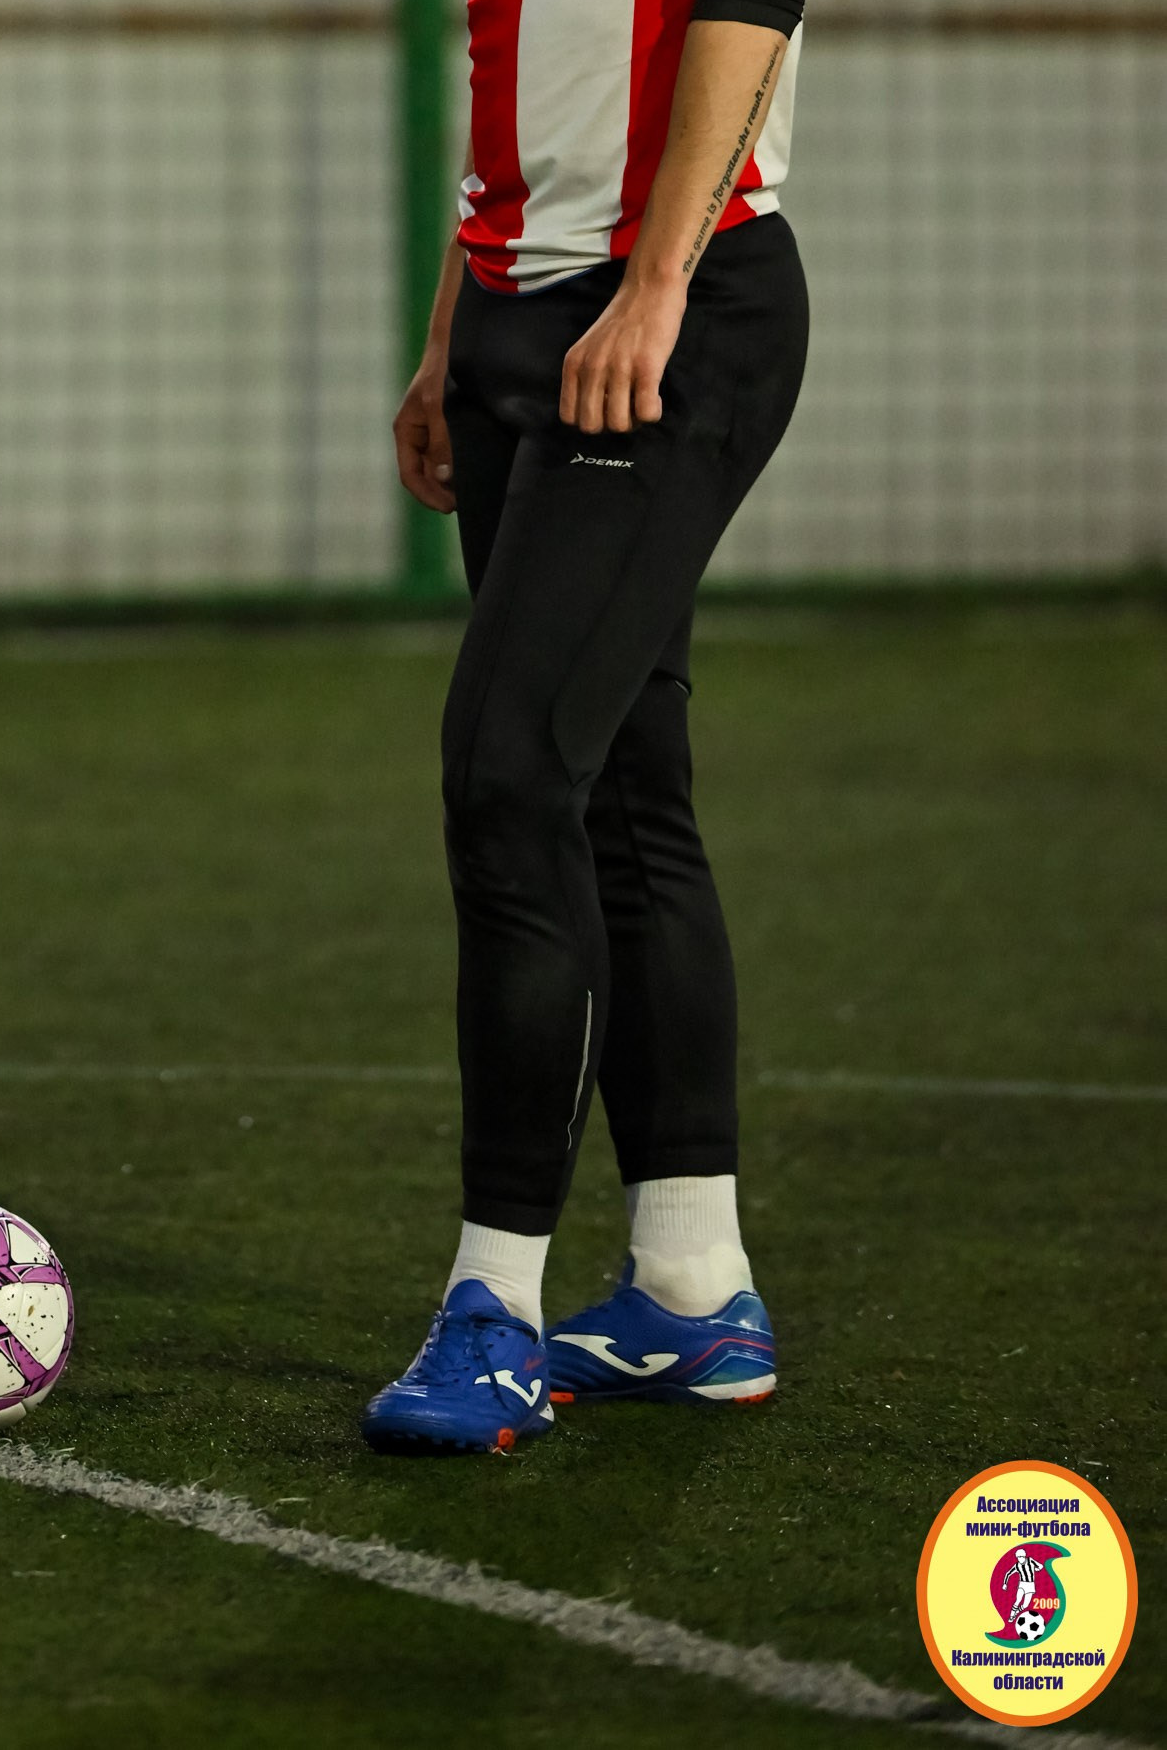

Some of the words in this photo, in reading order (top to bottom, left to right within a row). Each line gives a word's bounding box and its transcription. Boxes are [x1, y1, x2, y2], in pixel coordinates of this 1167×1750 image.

[682, 252, 695, 274] The
[693, 216, 712, 253] game
[707, 202, 717, 215] is
[747, 89, 764, 127] result
[584, 457, 634, 468] DEMIX
